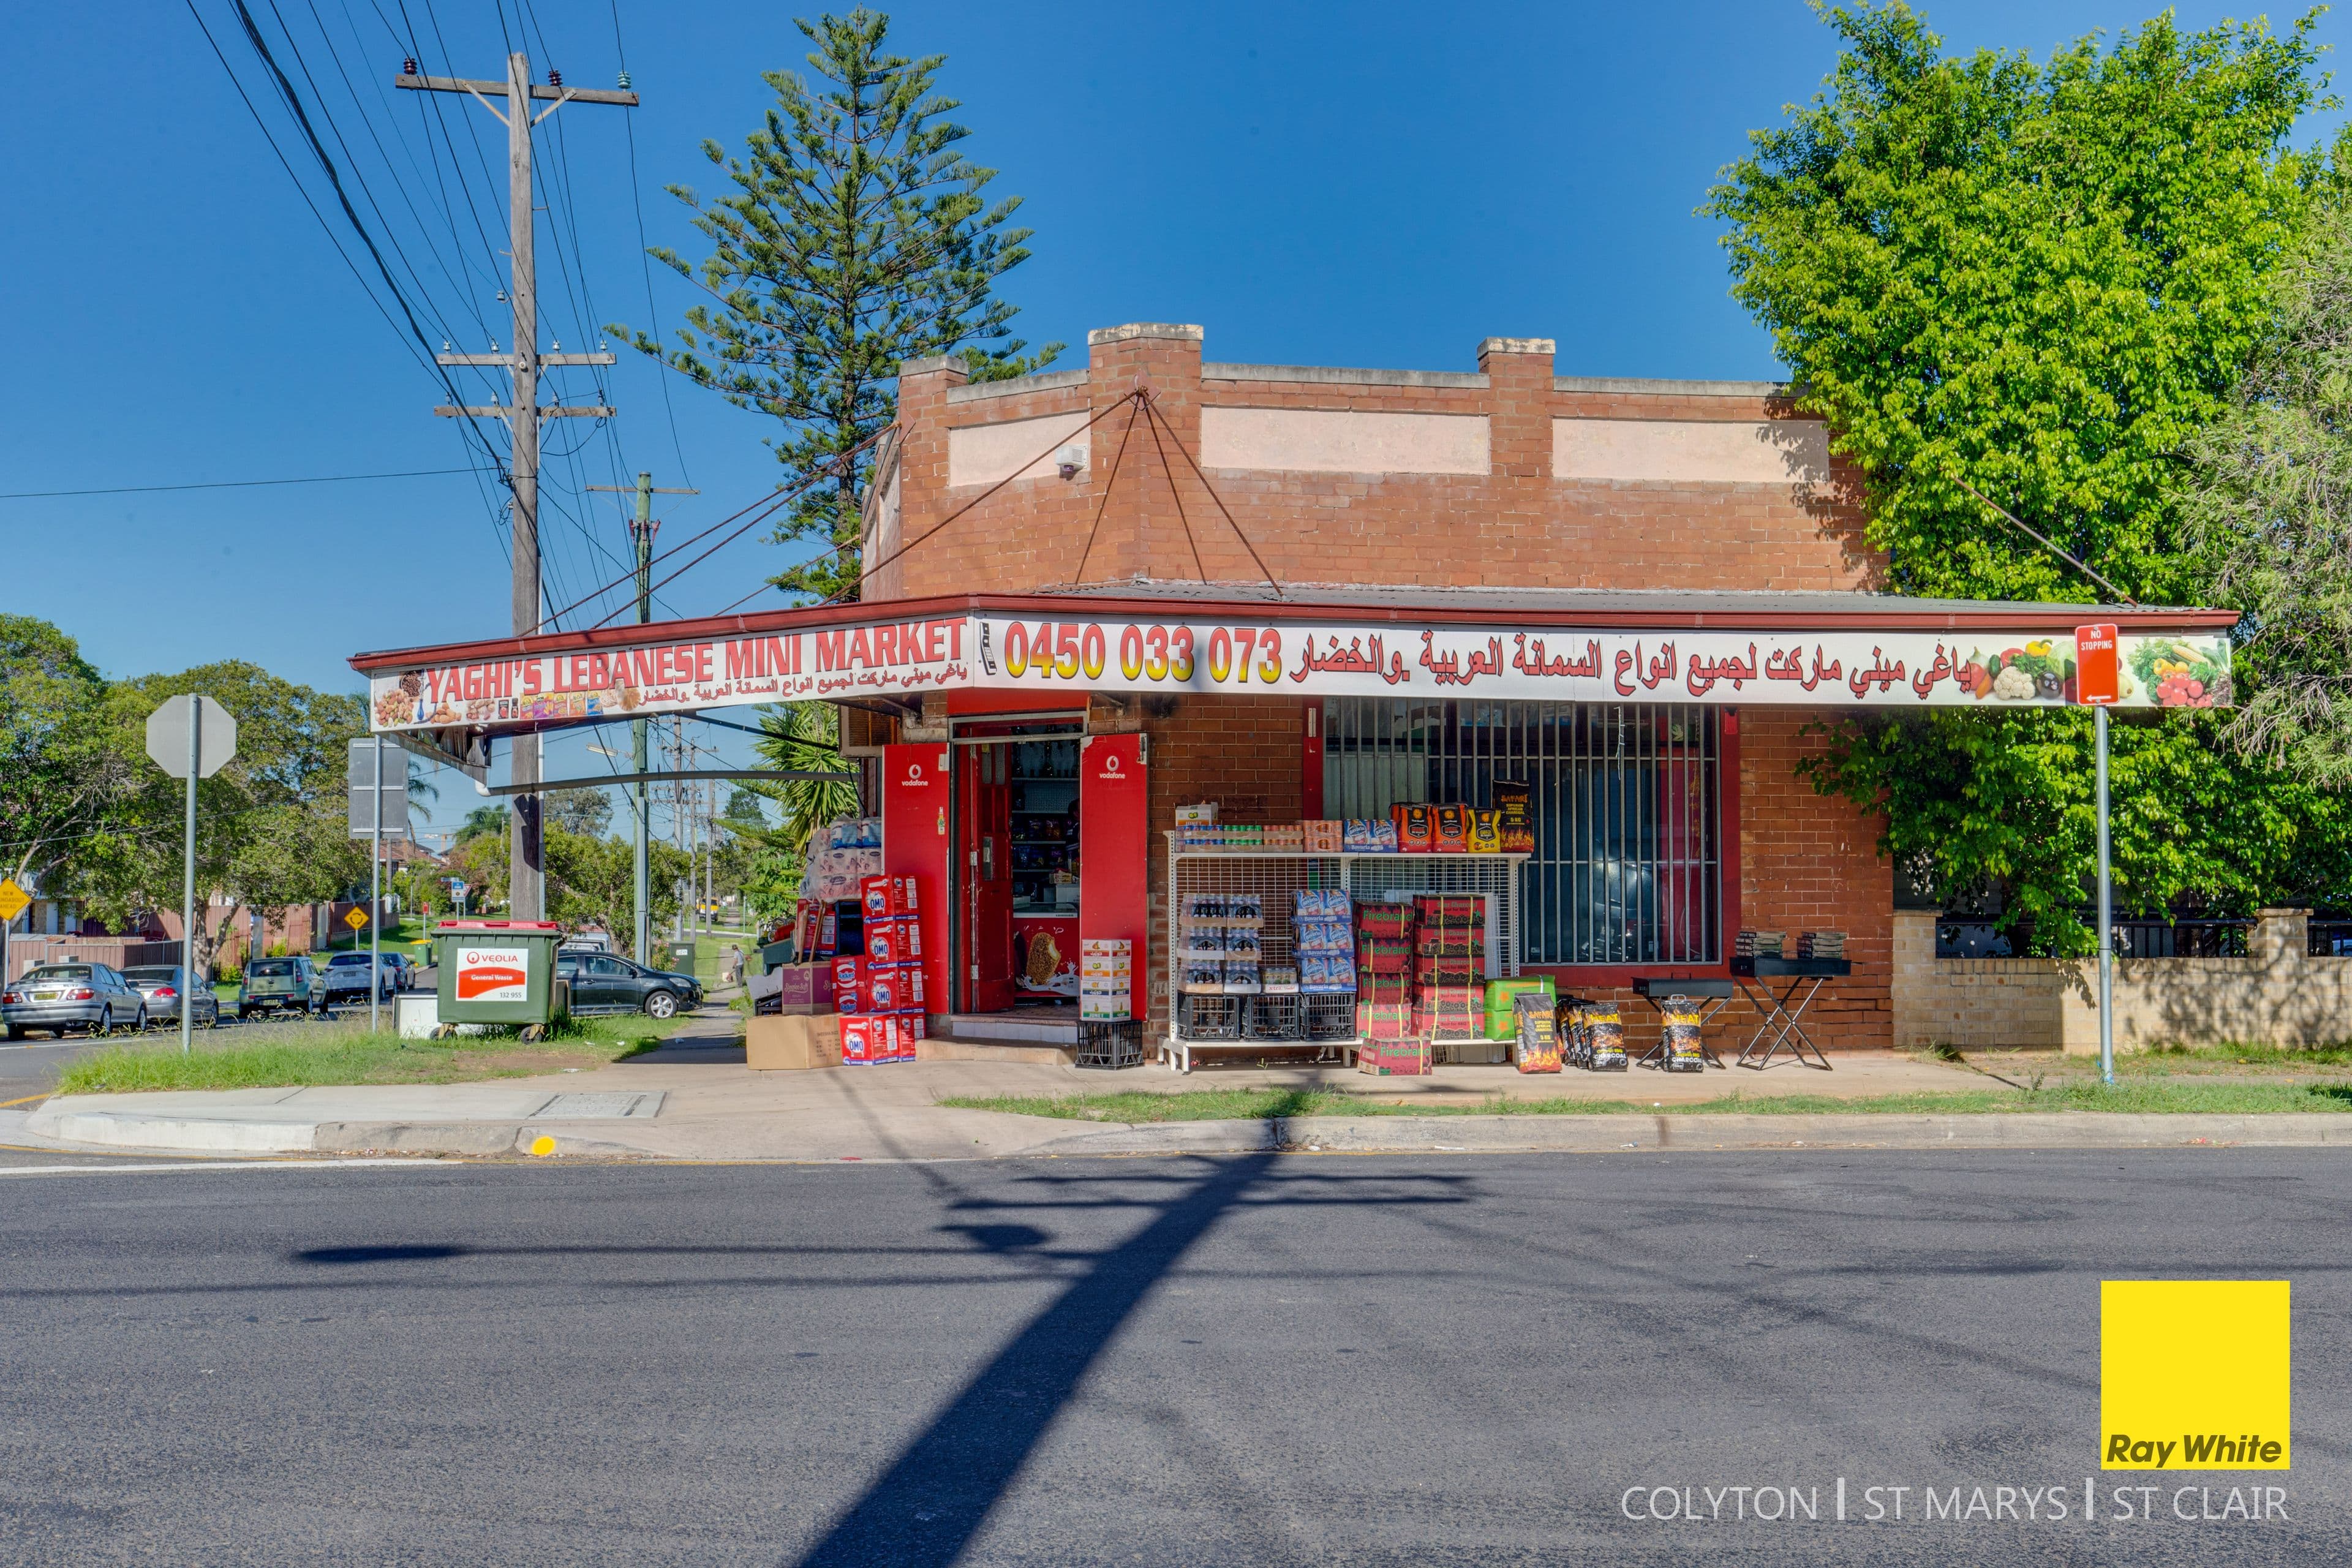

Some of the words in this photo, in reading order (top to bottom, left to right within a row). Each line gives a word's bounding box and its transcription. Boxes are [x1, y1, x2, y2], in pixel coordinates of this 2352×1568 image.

[2090, 630, 2101, 639] NO
[1005, 621, 1106, 680] 0450
[1120, 624, 1194, 682] 033
[1208, 627, 1282, 684] 073
[2081, 640, 2113, 650] STOPPING
[426, 656, 542, 704] YAGHI'S
[554, 642, 713, 693] LEBANESE
[725, 633, 802, 681] MINI
[815, 616, 967, 673] MARKET
[1419, 629, 1502, 686] العربية
[1512, 631, 1602, 679] السمانة
[935, 662, 968, 684] ياغي
[1687, 641, 1757, 697] لجميع
[1765, 643, 1842, 692] ماركت
[1849, 645, 1905, 699] ميني
[1912, 643, 1972, 701] ياغي
[818, 673, 855, 693] لجميع
[858, 671, 898, 687] ماركت
[901, 667, 931, 688] ميني
[694, 683, 731, 701] العربية
[870, 898, 884, 909] OMO
[1363, 910, 1412, 921] Firebrand
[874, 944, 888, 955] OMO
[1363, 978, 1412, 988] Fiebrand
[876, 991, 889, 1001] OMO
[1590, 1013, 1618, 1023] HEAT
[1672, 1014, 1699, 1024] HEAT
[850, 1041, 864, 1051] OMO
[1380, 1046, 1431, 1057] Firebrand
